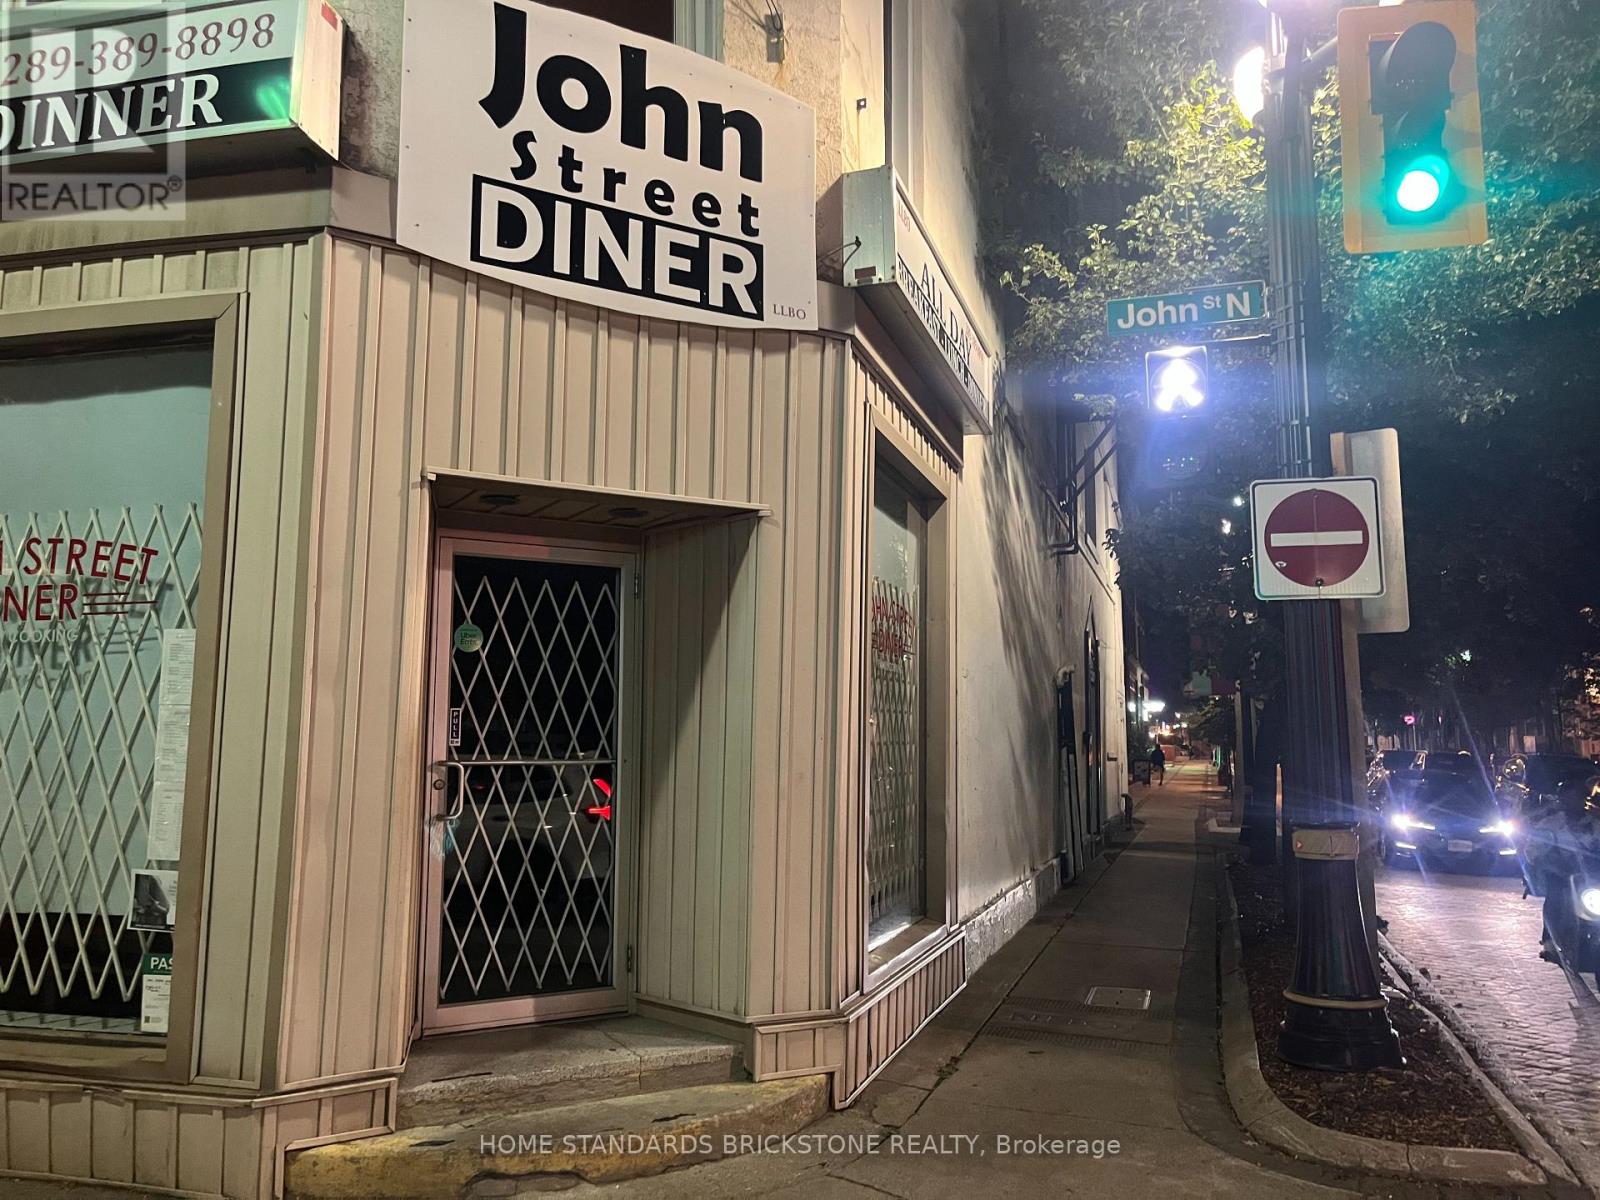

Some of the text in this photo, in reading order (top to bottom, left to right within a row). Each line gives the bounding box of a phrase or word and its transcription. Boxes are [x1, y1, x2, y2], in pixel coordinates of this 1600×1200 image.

[1, 13, 275, 87] 289-389-8898
[478, 2, 763, 184] John
[509, 130, 760, 238] Street
[479, 182, 758, 314] DINER
[772, 303, 807, 321] LLBO
[921, 263, 972, 367] ALL DAY
[1117, 291, 1251, 327] John St N
[23, 537, 159, 585] STREET
